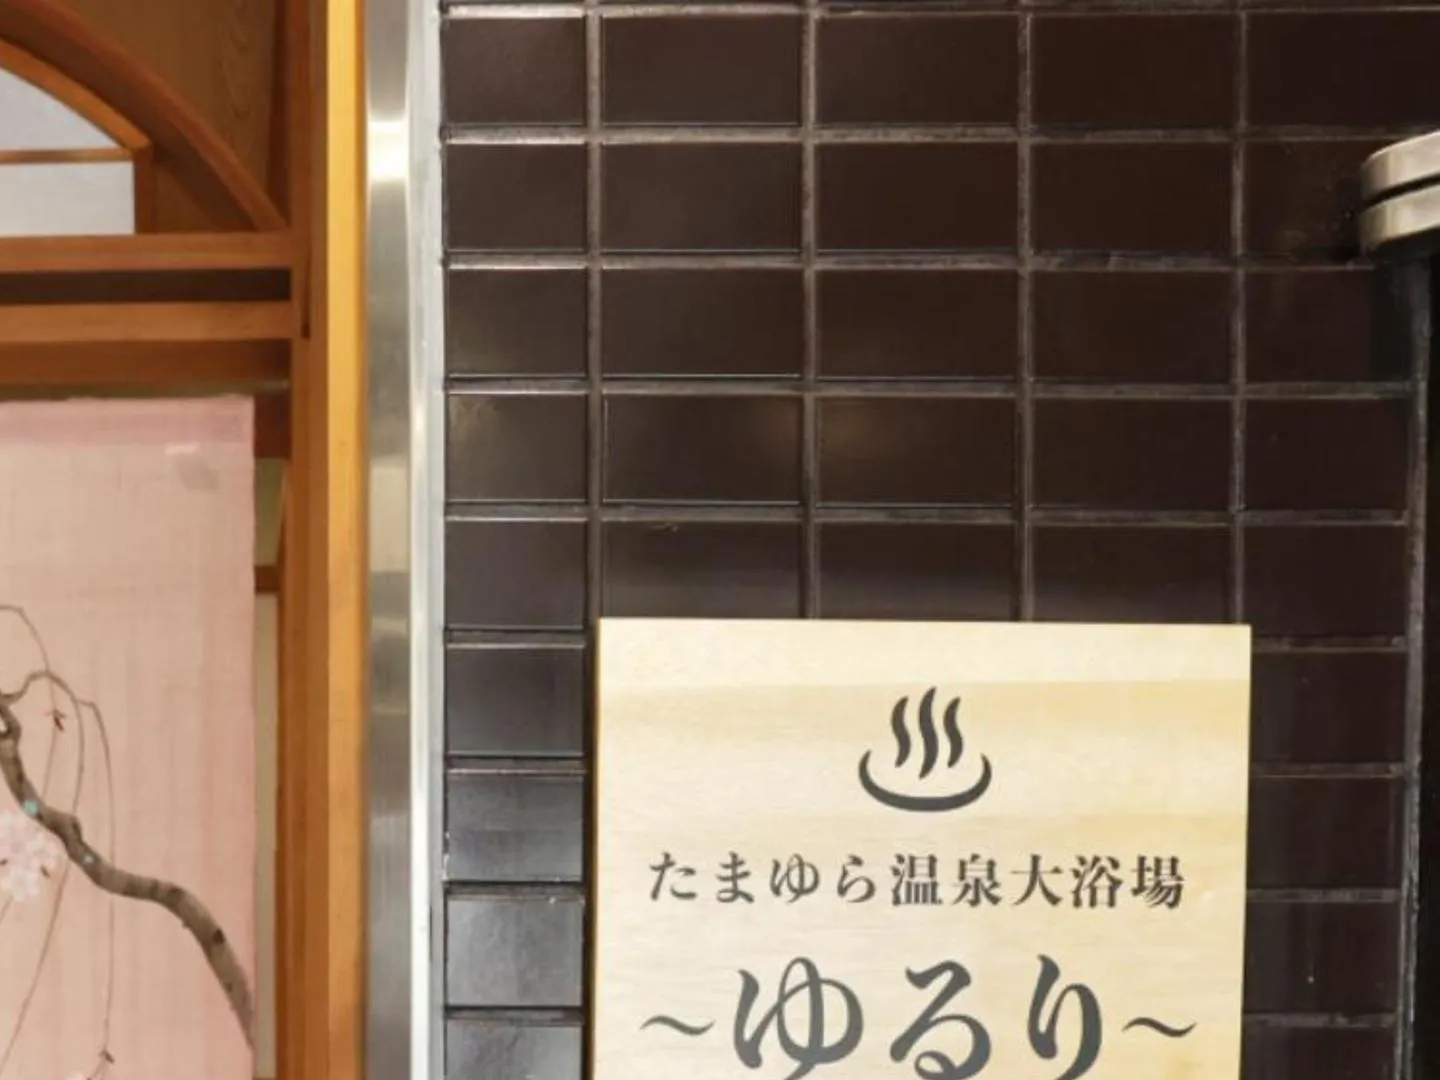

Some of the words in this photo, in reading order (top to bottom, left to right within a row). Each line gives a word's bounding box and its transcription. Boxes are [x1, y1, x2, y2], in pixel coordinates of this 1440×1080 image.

[649, 851, 1186, 909] たまゆら温泉大浴場
